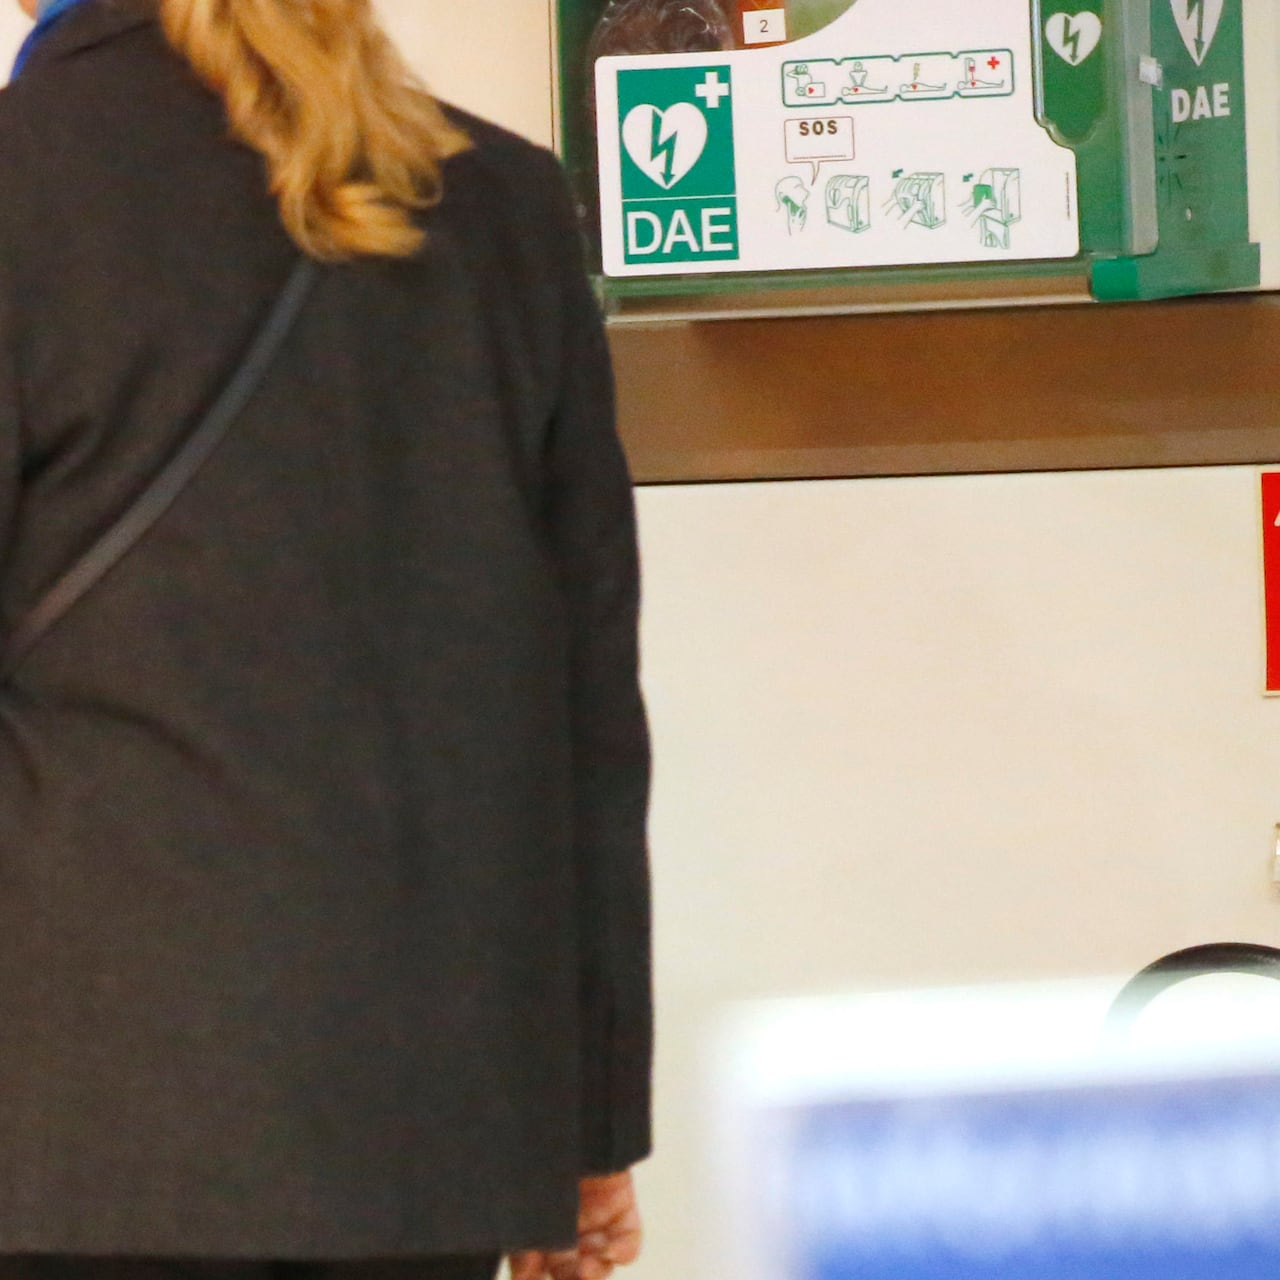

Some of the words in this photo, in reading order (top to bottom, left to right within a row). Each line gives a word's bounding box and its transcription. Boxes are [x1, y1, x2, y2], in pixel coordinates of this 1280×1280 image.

[759, 19, 769, 33] 2
[1171, 83, 1231, 125] DAE
[799, 119, 838, 136] SOS
[625, 206, 733, 256] DAE
